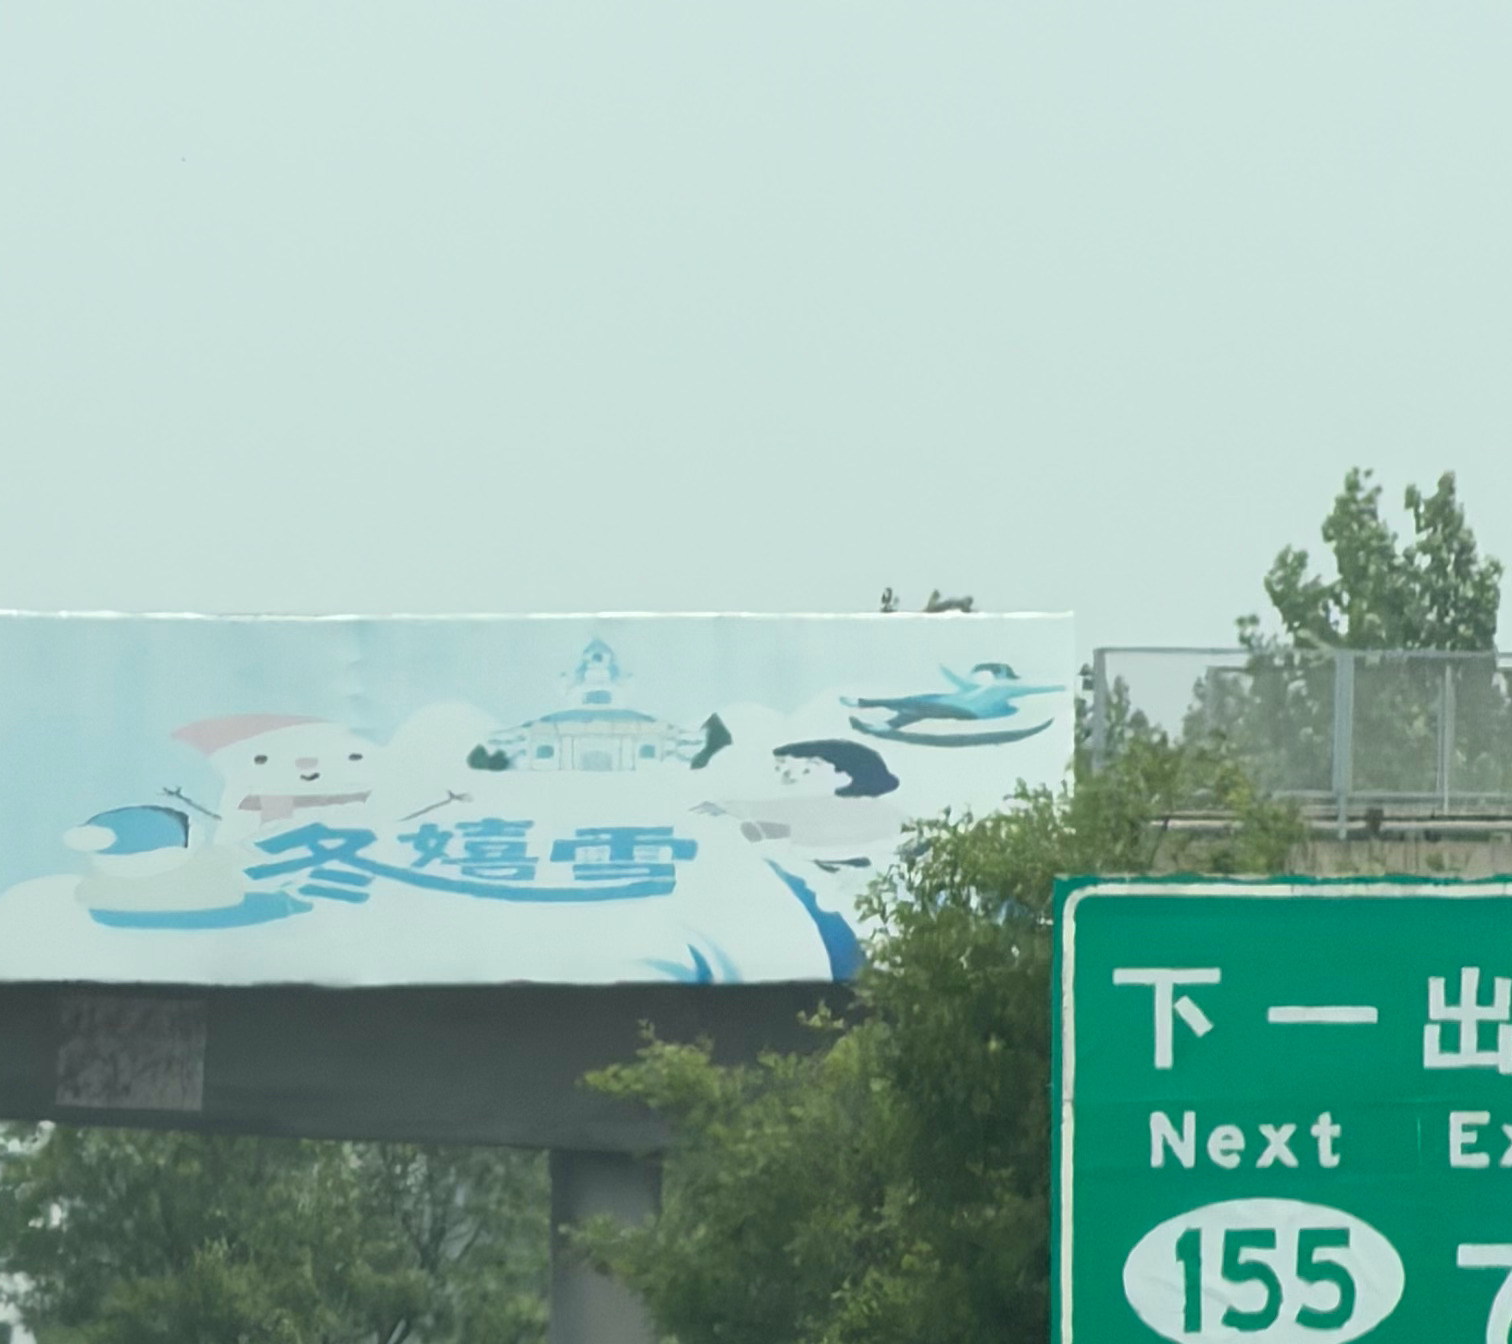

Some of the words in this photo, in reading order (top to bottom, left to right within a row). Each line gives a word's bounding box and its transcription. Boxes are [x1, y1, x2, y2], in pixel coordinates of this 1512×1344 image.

[244, 817, 698, 903] 冬嬉雪
[1149, 1111, 1342, 1169] Next
[1175, 1226, 1357, 1333] 155
